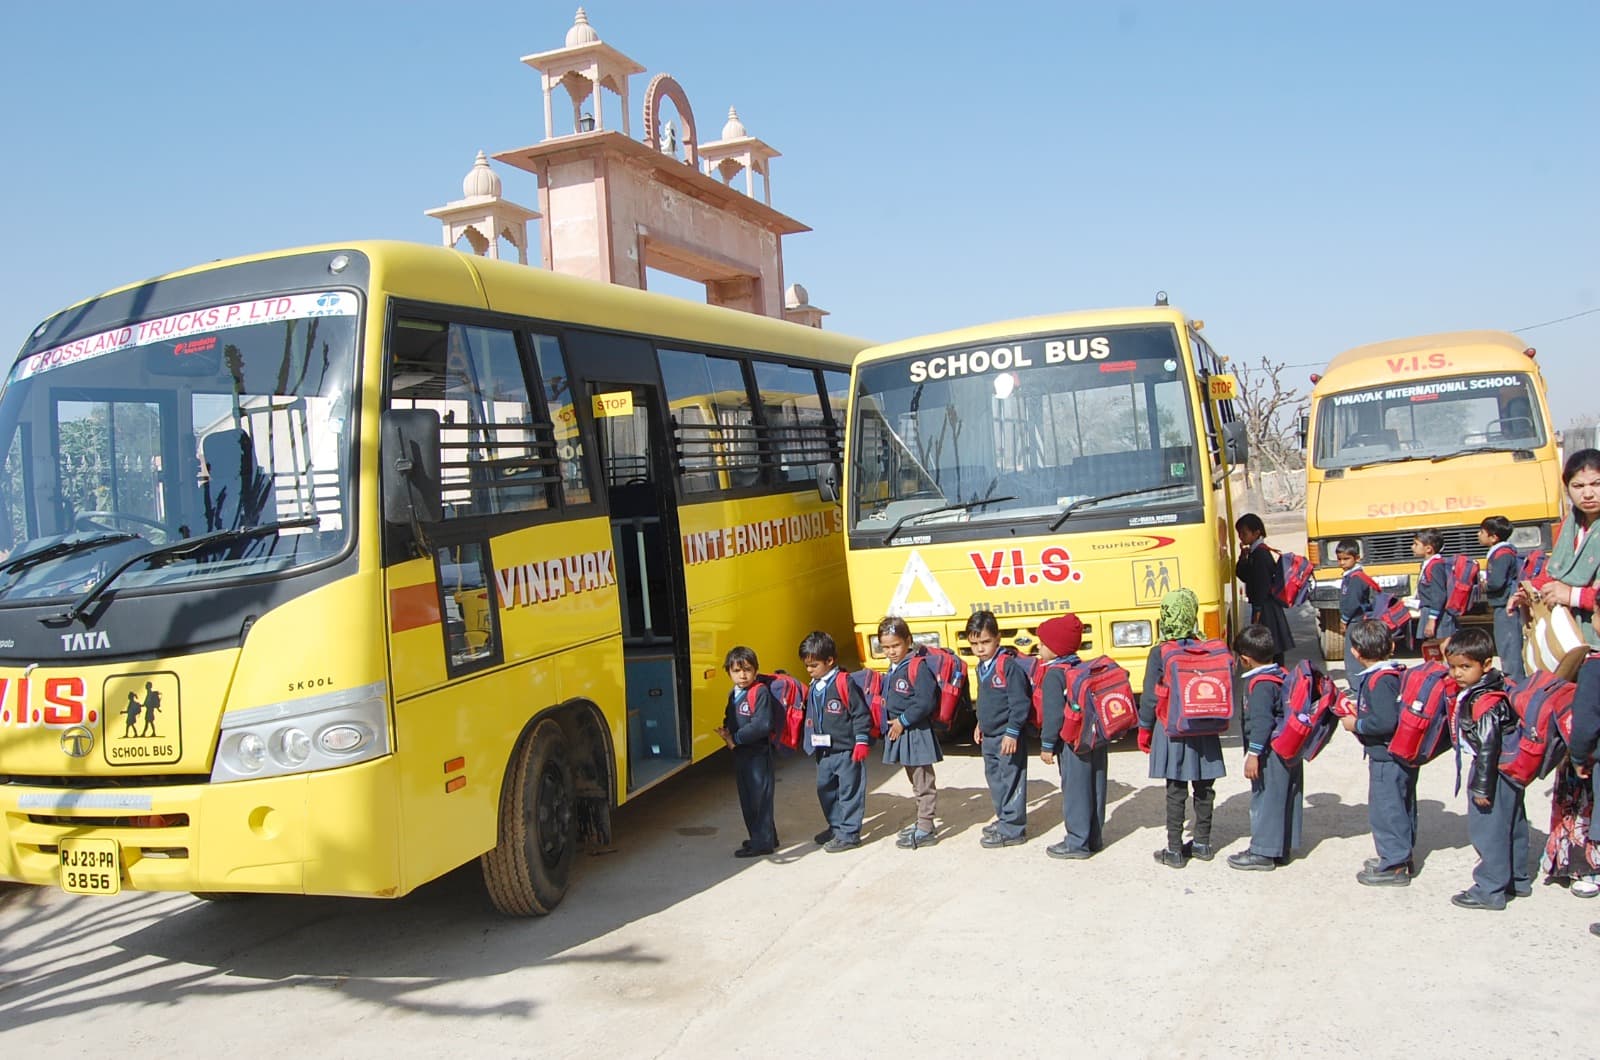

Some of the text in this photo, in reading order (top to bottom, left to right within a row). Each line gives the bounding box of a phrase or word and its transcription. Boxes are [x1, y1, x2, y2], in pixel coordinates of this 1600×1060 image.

[29, 325, 133, 371] CROSSLAND
[138, 308, 219, 340] TRUCKS
[225, 305, 241, 322] P.
[249, 297, 296, 319] LTD.
[910, 336, 1110, 383] SCHOOL BUS
[1386, 353, 1453, 374] V.I.S.
[1211, 381, 1232, 394] STOP
[1334, 392, 1383, 406] VINAYAK
[1386, 381, 1468, 398] INTERNATIONAL
[1469, 375, 1521, 391] SCHOOL
[596, 397, 628, 412] STOP
[1367, 496, 1486, 517] SCHOOL BUS
[684, 512, 830, 566] INTERNATIONAL
[1091, 540, 1151, 550] tourister
[969, 547, 1083, 588] V.I.S.
[495, 550, 616, 610] VINAYAK
[61, 630, 111, 652] TATA
[288, 677, 334, 692] SKOOL
[0, 677, 98, 725] .I.S.
[112, 745, 173, 758] SCHOOL BUS
[67, 873, 110, 889] 3856
